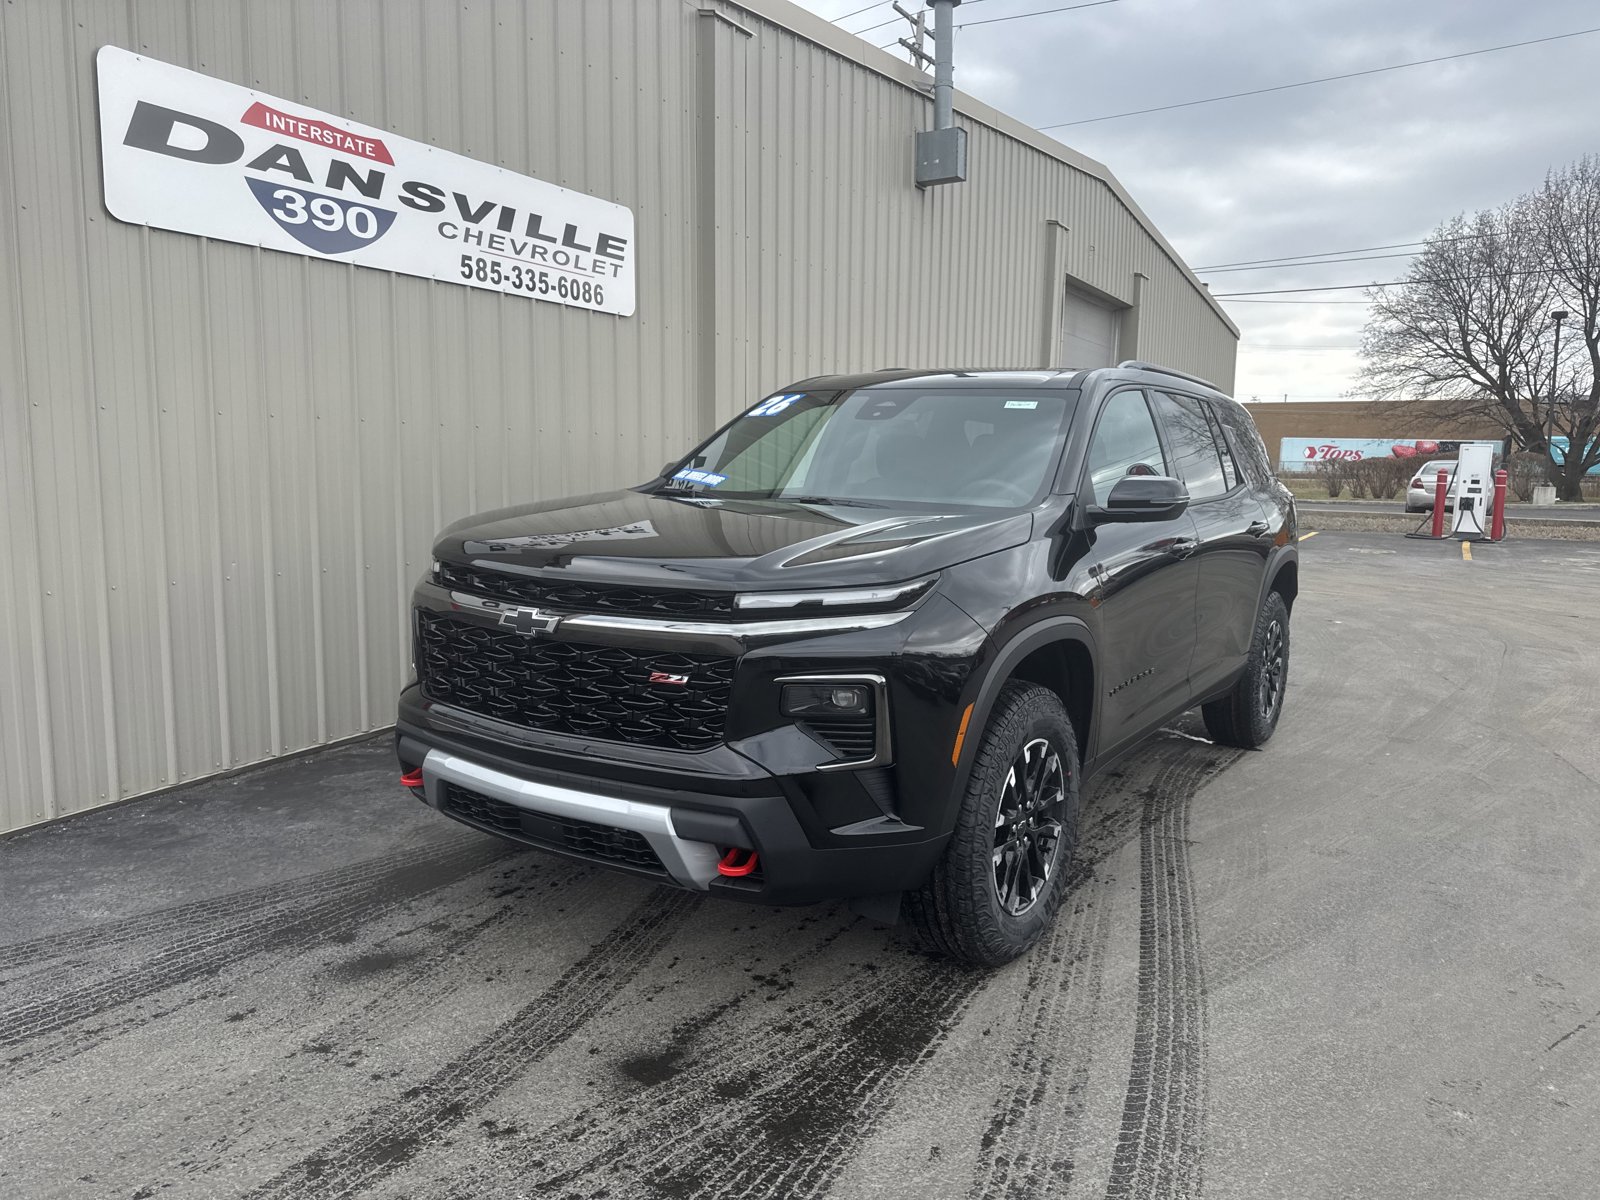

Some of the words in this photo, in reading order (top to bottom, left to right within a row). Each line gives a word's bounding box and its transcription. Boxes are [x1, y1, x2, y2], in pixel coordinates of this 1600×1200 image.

[265, 112, 376, 157] INTERSTATE
[122, 100, 628, 262] DANSVILLE
[272, 189, 378, 240] 390
[437, 221, 623, 278] CHEVROLET
[460, 254, 604, 306] 585-335-6086
[747, 394, 801, 416] 26
